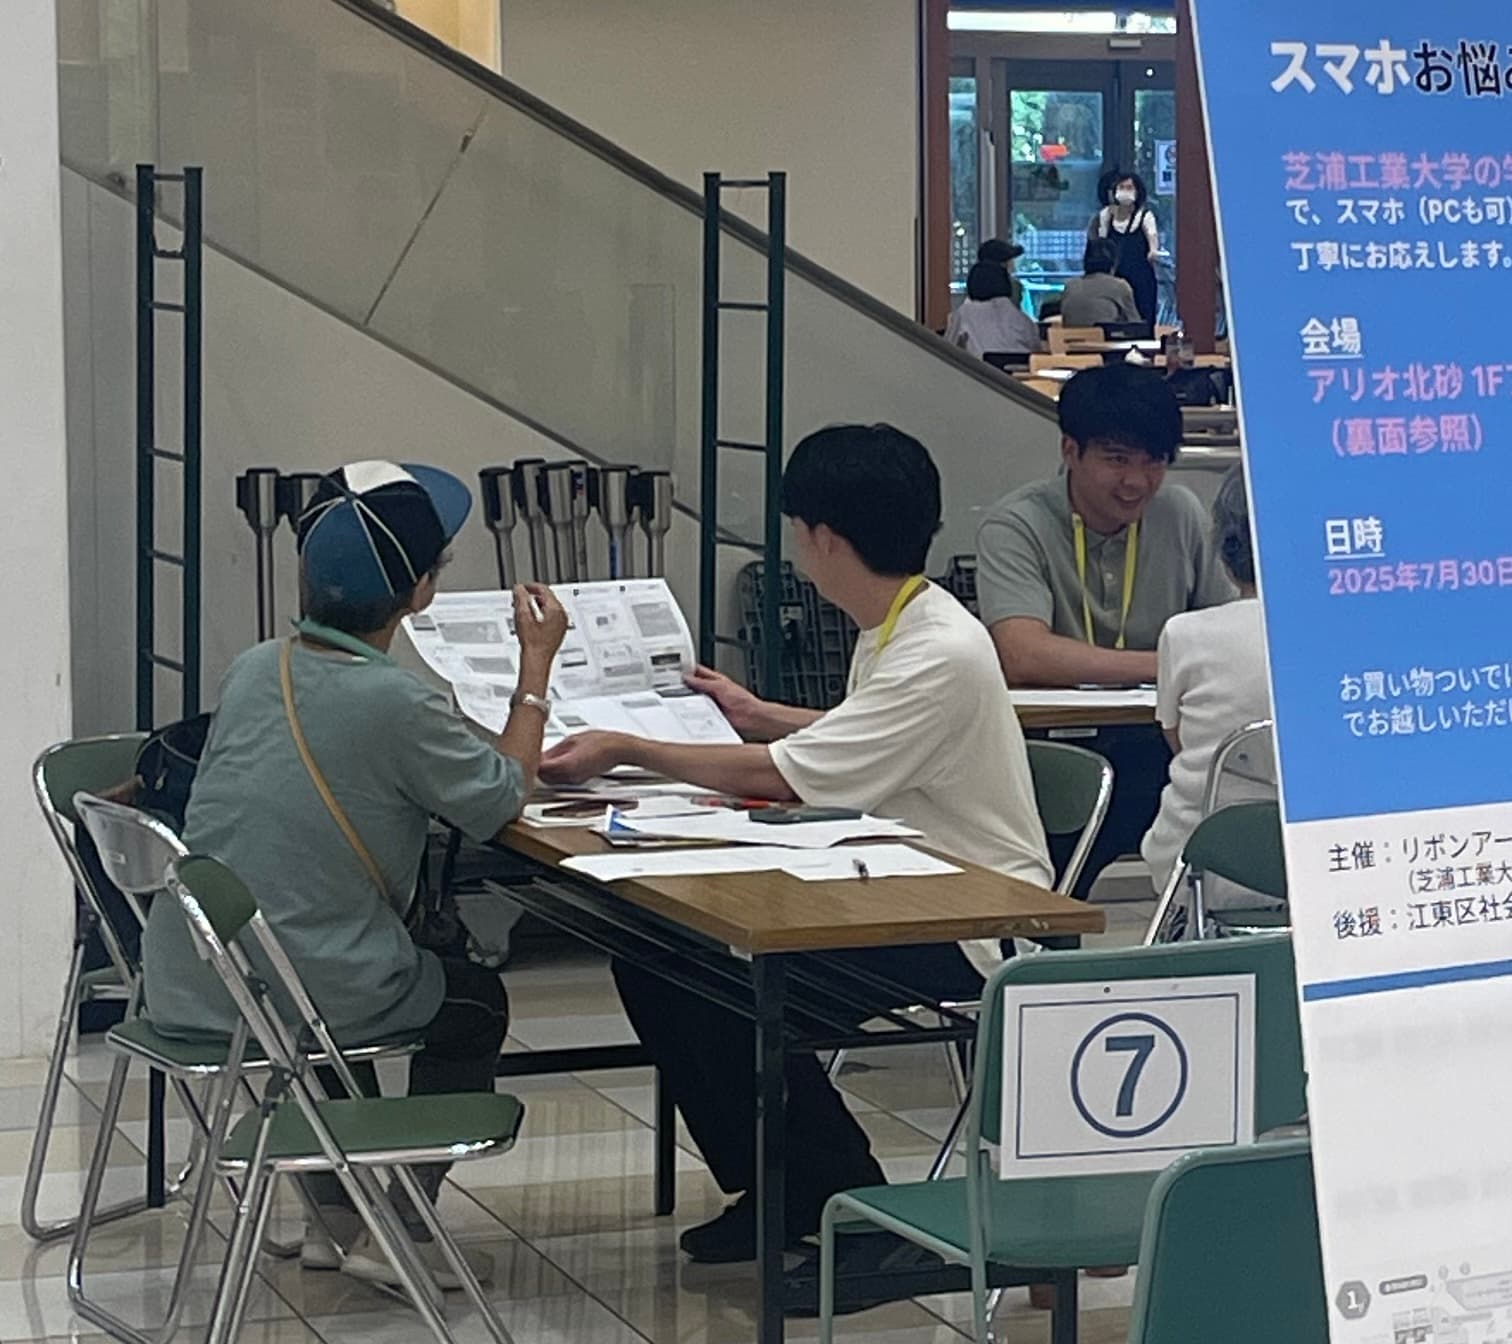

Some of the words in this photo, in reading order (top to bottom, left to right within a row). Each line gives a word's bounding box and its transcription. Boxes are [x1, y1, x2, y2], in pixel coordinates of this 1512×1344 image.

[1299, 316, 1362, 355] 会場
[1306, 364, 1463, 404] アリオ北砂
[1332, 413, 1484, 457] （裏面参照）
[1324, 516, 1383, 555] 日時
